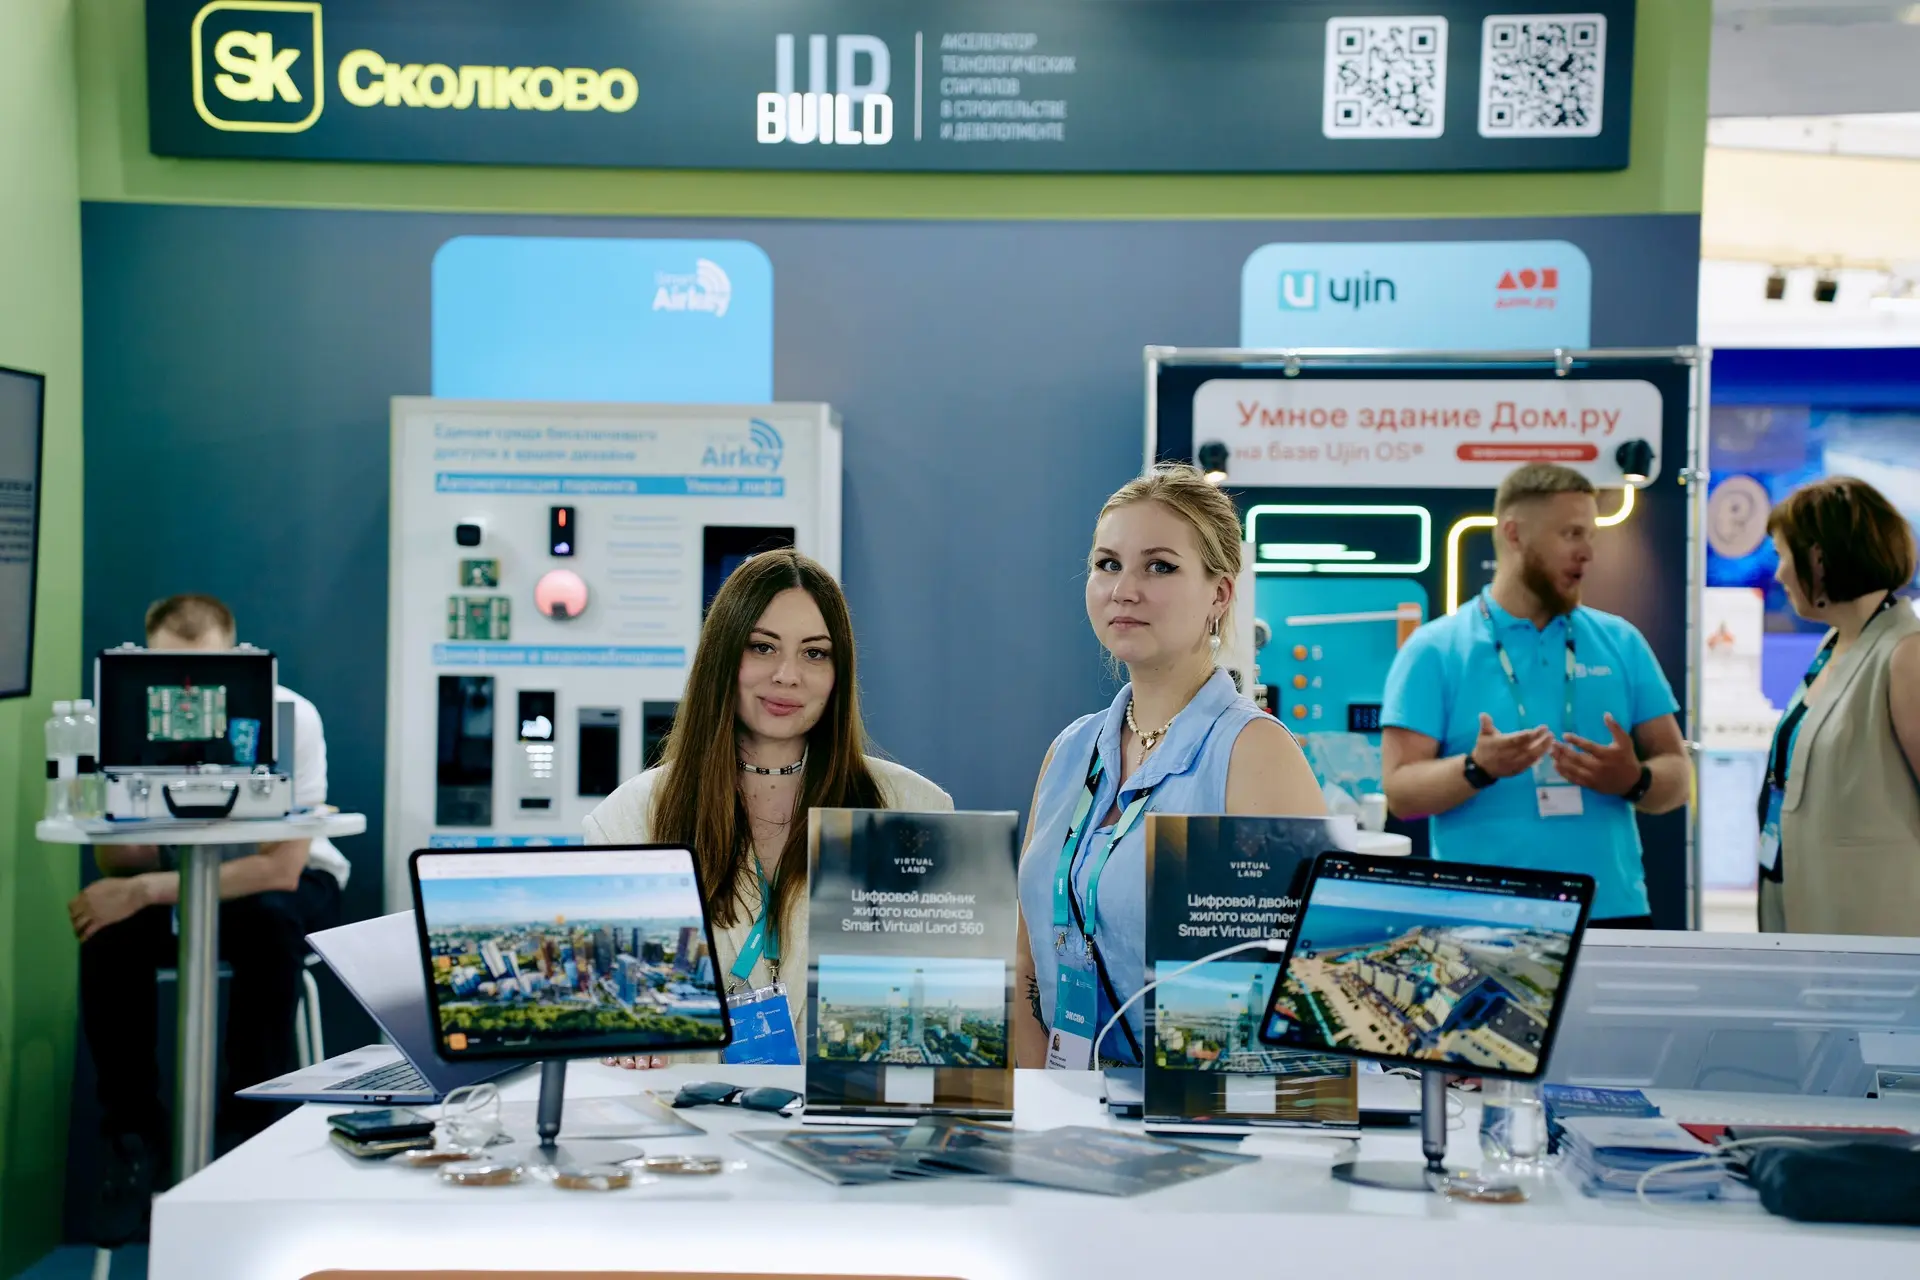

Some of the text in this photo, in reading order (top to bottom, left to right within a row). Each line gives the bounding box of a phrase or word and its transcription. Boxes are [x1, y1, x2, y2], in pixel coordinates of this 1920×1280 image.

[214, 31, 302, 103] Sk
[757, 92, 893, 145] BUILD
[1237, 402, 1620, 435] Умное здание Дом.ру
[702, 445, 782, 473] Airkey
[1235, 446, 1262, 461] на
[1325, 442, 1369, 466] Ujin
[894, 858, 934, 866] VIRTUAL
[1230, 861, 1271, 870] VIRTUAL
[901, 866, 926, 874] LAND
[1238, 870, 1263, 878] LAND
[851, 889, 976, 905] Цифровой двойник
[1187, 893, 1302, 909] Цифровой двойн
[853, 906, 973, 920] жилого комплекса
[1189, 911, 1297, 924] жилого комплек
[841, 919, 984, 935] Smart Virtual Land 360
[1178, 924, 1217, 937] Smart
[1219, 925, 1261, 938] Virtual
[1065, 1010, 1085, 1024] ЭКСПО
